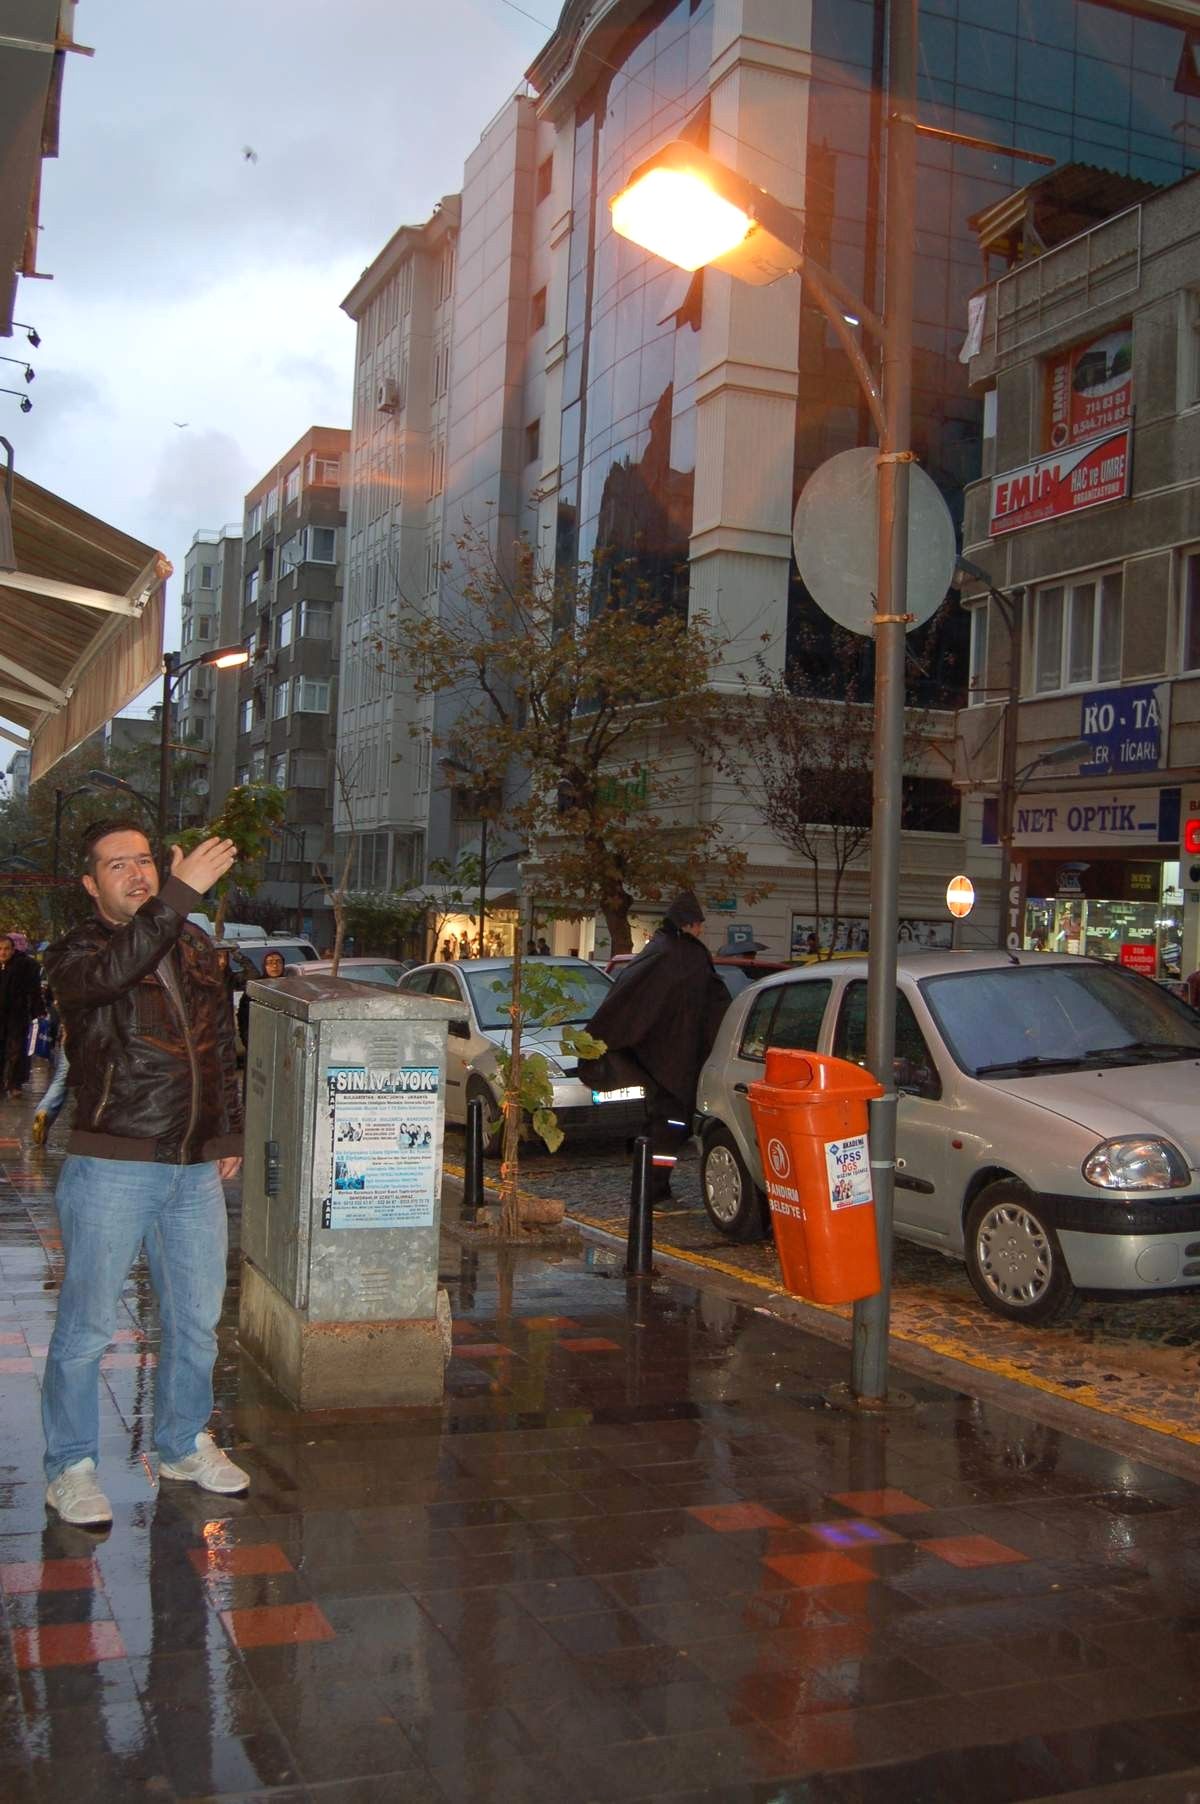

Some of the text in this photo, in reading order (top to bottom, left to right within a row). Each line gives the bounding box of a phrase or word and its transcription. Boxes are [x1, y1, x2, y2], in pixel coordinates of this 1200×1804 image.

[996, 464, 1062, 517] EMİN
[1017, 796, 1136, 834] NET OPTİK
[400, 1071, 433, 1091] YOK
[836, 1150, 862, 1165] KPSS
[842, 1161, 858, 1173] DGS
